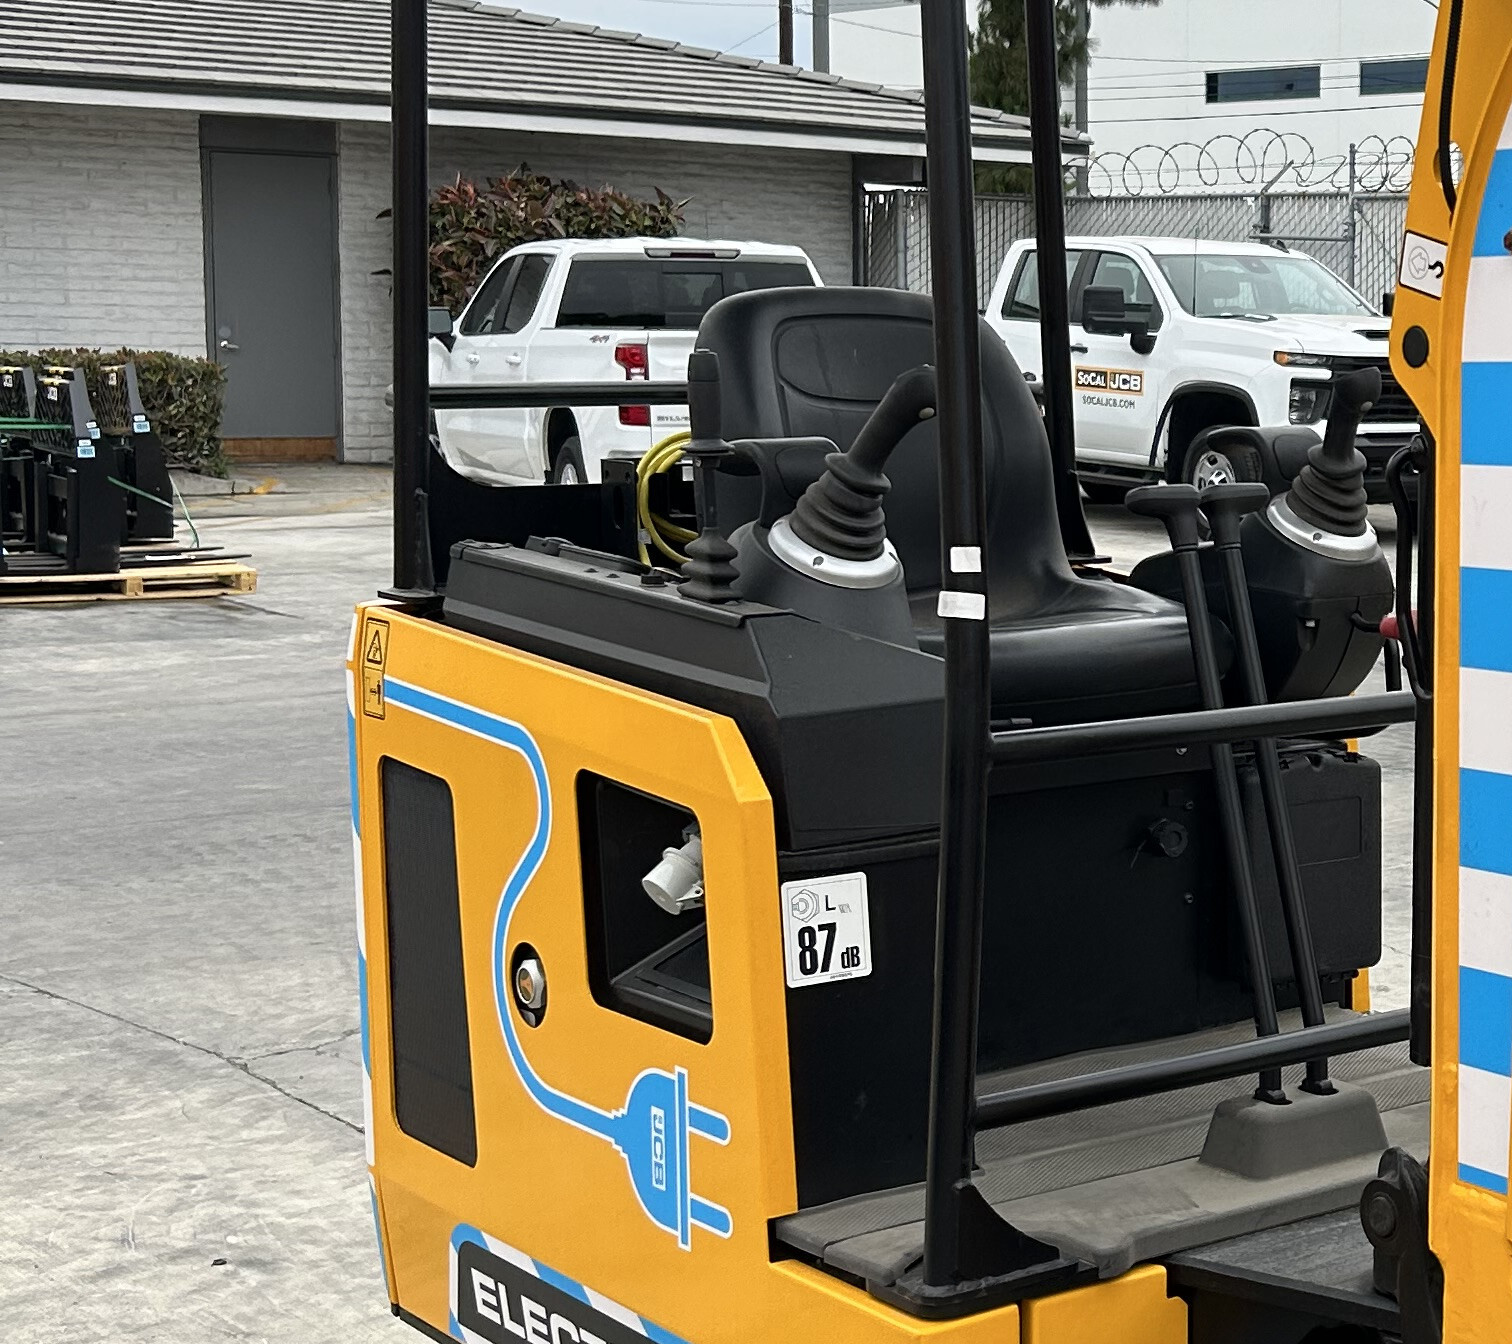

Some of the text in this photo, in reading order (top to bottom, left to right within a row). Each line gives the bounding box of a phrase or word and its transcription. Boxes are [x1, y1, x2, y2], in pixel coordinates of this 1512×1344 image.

[1110, 373, 1141, 391] JCB
[797, 922, 861, 976] 87 dB
